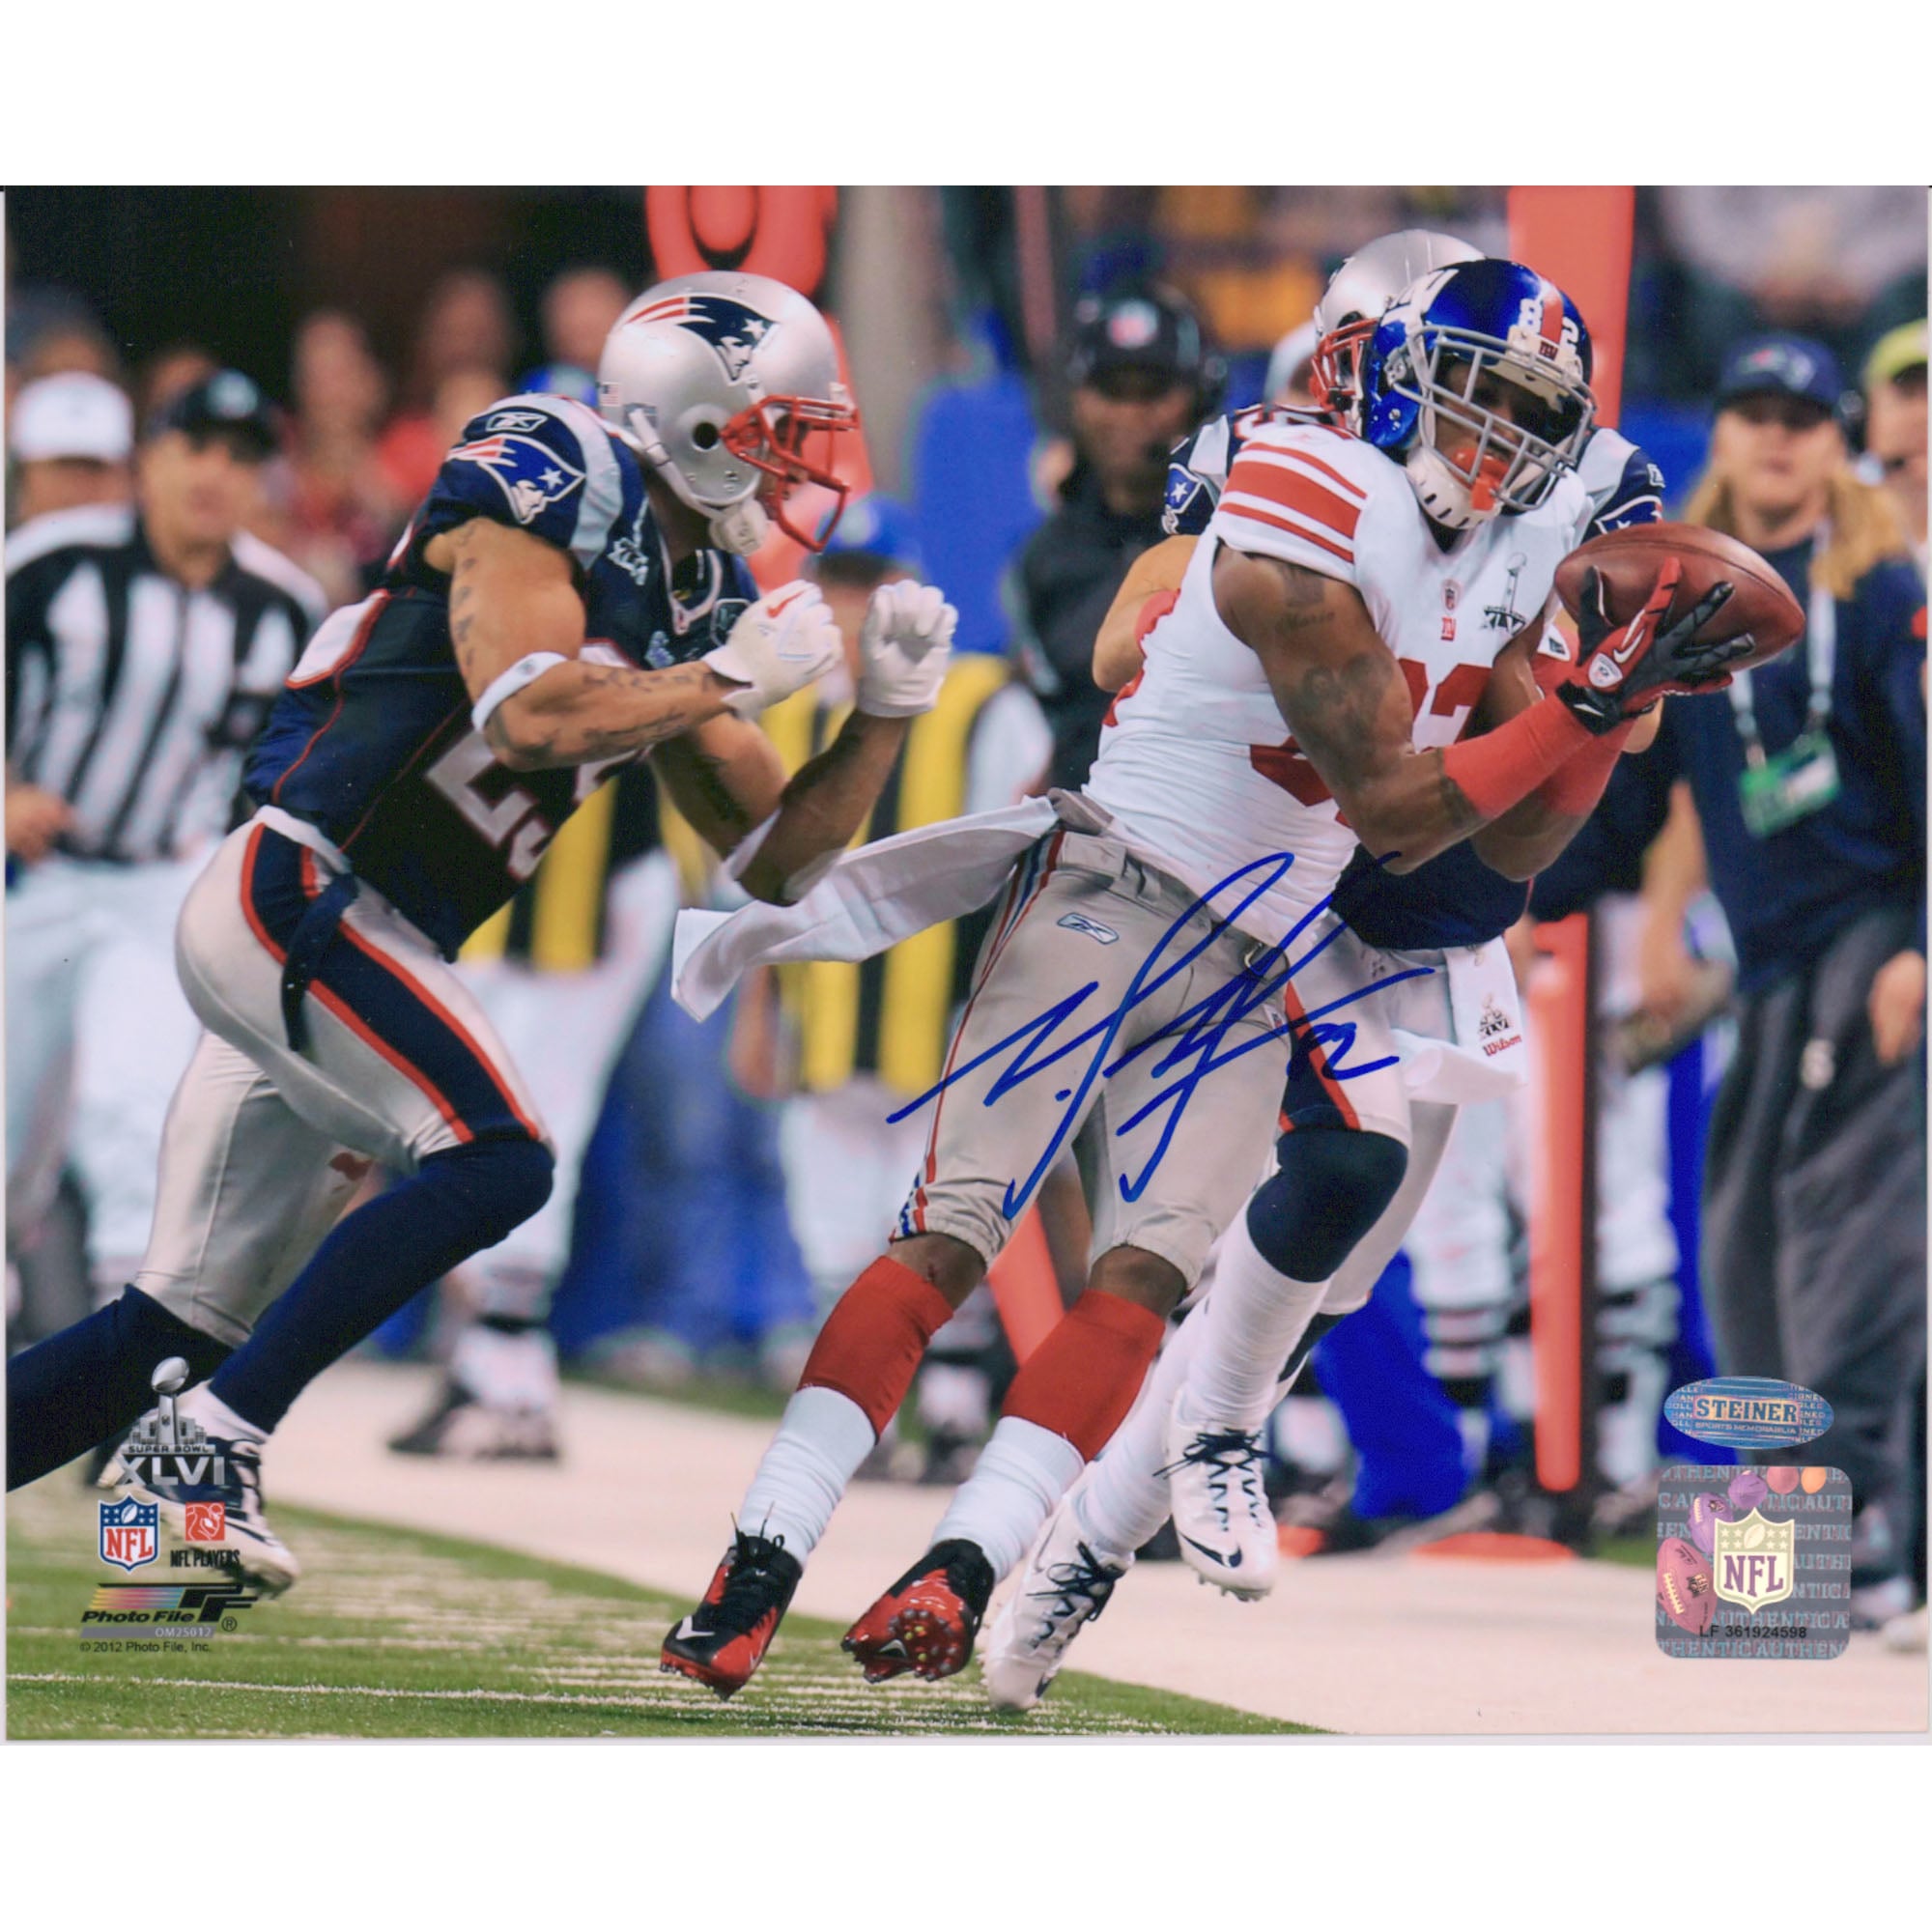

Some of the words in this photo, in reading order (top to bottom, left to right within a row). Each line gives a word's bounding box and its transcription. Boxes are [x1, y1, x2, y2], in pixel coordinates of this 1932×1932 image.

[1483, 1035, 1522, 1057] Wilson
[1696, 1398, 1799, 1423] STEINER
[1694, 1421, 1733, 1431] SPORTS
[1734, 1423, 1797, 1435] MEMORABILIA
[1723, 1555, 1784, 1598] NFL
[1699, 1624, 1719, 1638] LF
[1725, 1625, 1807, 1639] 361924598
